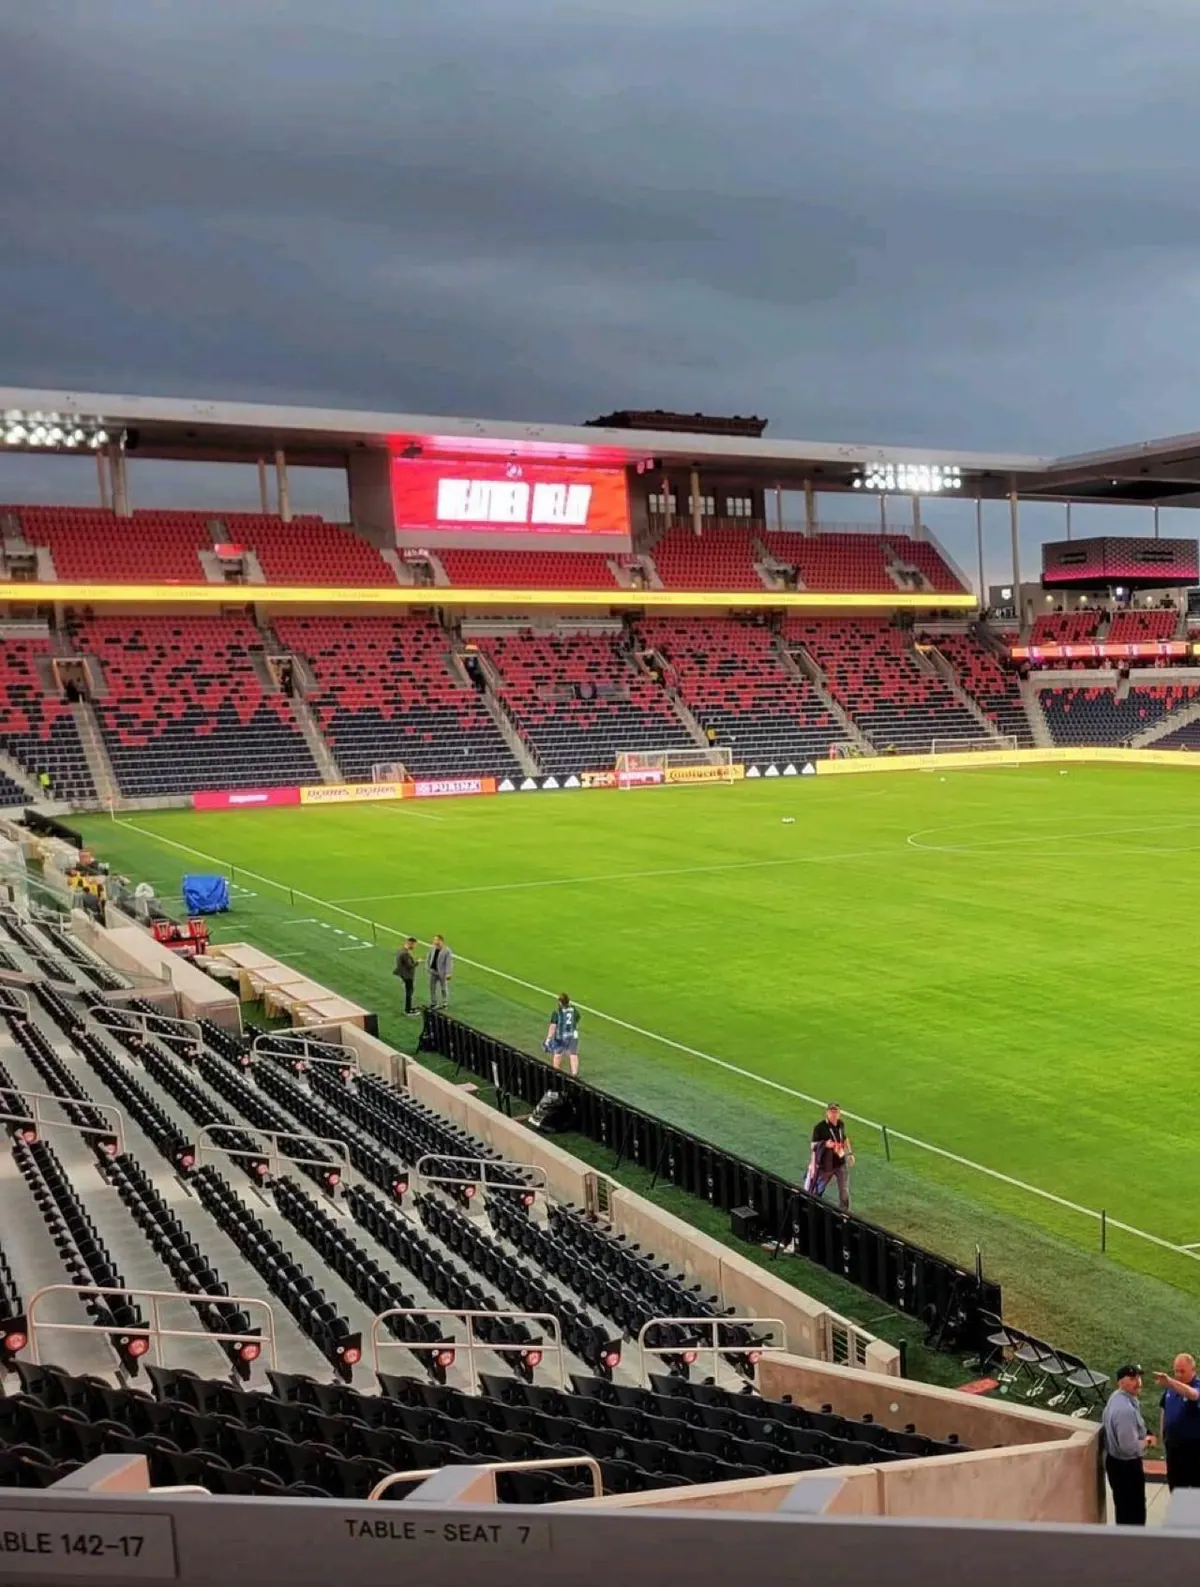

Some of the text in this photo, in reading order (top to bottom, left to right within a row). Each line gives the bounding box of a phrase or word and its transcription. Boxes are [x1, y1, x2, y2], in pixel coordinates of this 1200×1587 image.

[0, 1531, 144, 1557] BLE 142-17
[345, 1519, 416, 1540] TABLE
[443, 1523, 502, 1543] SEAT
[517, 1526, 531, 1544] 7
